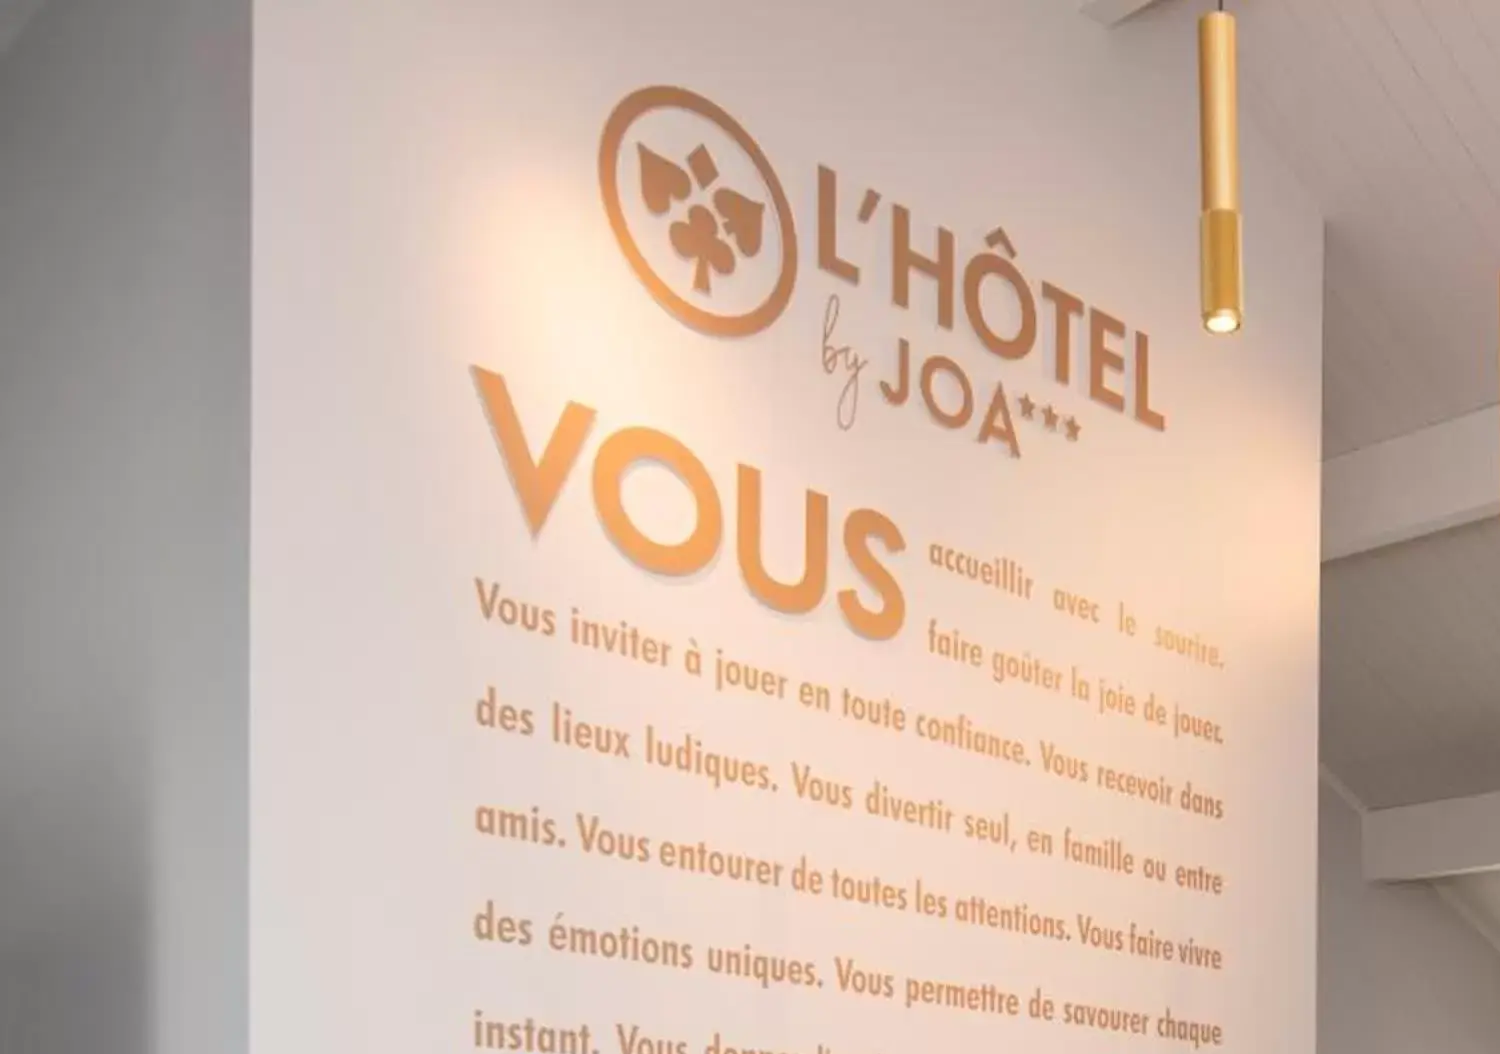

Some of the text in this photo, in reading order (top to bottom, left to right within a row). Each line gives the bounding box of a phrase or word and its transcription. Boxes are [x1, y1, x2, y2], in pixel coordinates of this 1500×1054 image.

[818, 163, 1166, 432] L'HÔTEL
[822, 294, 869, 431] by
[470, 364, 906, 641] VOUS
[928, 619, 982, 667] faire
[992, 646, 1063, 691] goûter
[1071, 666, 1090, 702] la
[1099, 679, 1136, 716] joie
[1143, 693, 1167, 726] de
[929, 543, 1224, 669] accueillir avec le sourire.
[475, 577, 1223, 819] Vous inviter à jouer en toute confiance. Vous recevoir dans
[476, 686, 1222, 895] des lieux ludiques. Vous divertir seul, en famille ou entre
[476, 806, 1222, 970] amis. Vous entourer de toutes les attentions. Vous faire vivre
[474, 900, 1222, 1049] des émotions uniques. Vous permettre de savourer chaque
